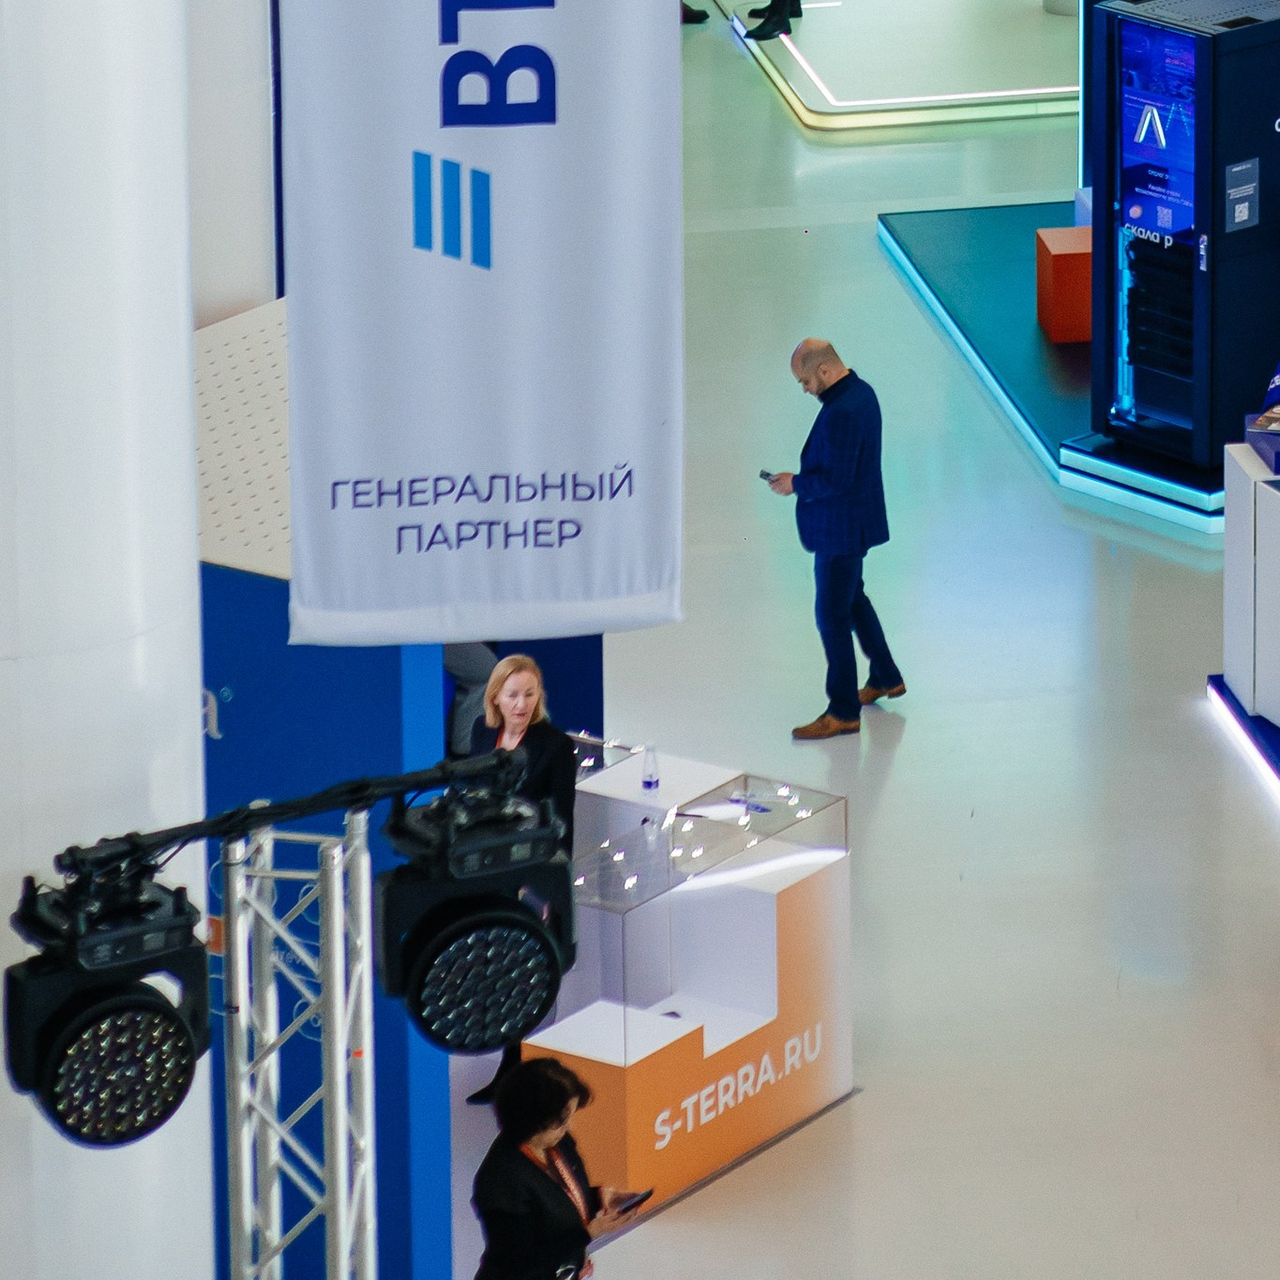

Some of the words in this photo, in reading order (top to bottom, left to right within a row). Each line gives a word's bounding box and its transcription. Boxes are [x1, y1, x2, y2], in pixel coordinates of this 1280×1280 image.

[331, 463, 635, 511] ГЕНЕРАЛЬНЫЙ
[396, 518, 583, 555] ПАРТНЕР
[654, 1025, 823, 1151] S-TERRA.RU
